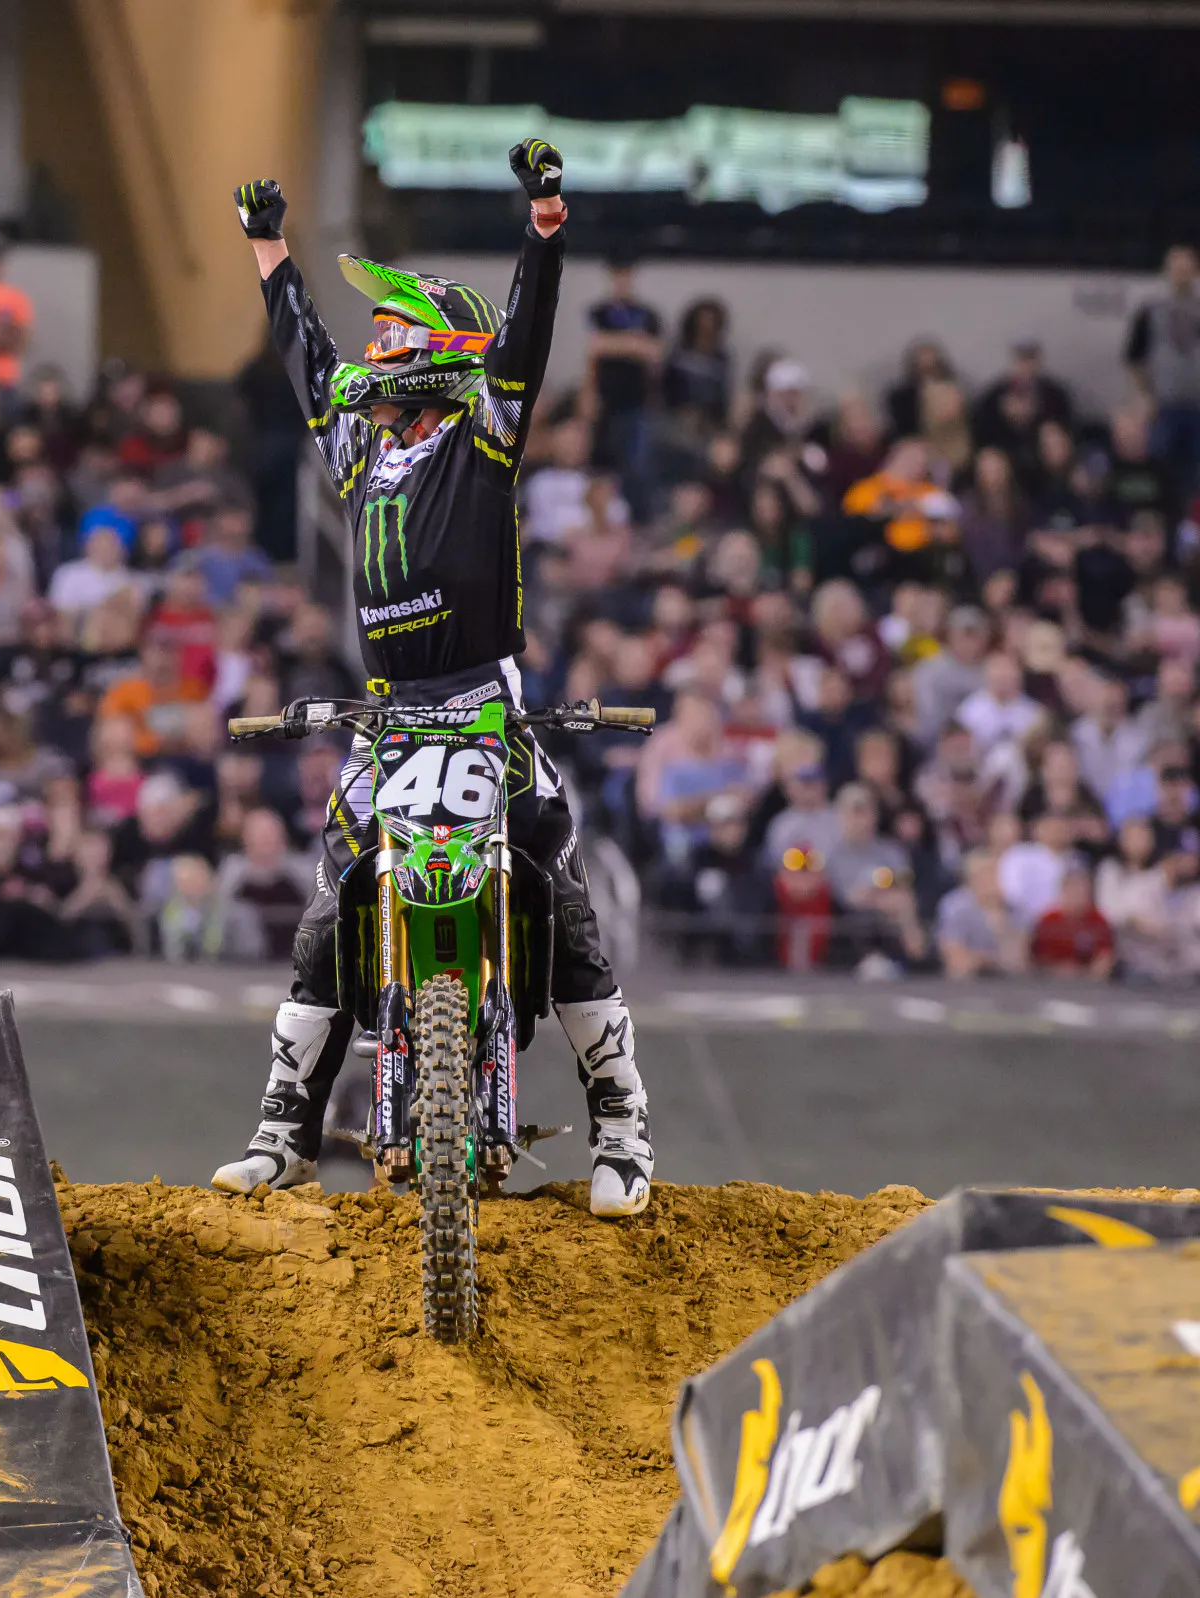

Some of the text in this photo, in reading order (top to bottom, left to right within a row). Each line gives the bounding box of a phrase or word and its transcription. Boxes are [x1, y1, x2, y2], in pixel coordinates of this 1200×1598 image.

[418, 280, 446, 296] VANS
[398, 371, 461, 386] MONSTER
[408, 382, 451, 391] ENERGY
[360, 589, 443, 626] Kawasaki
[388, 610, 452, 635] CIRCUIT
[386, 711, 480, 726] RENTHA
[564, 721, 595, 731] ARC
[376, 745, 505, 819] 46
[316, 862, 329, 897] thor
[382, 885, 392, 981] PRO CIRCUIT
[382, 1045, 393, 1135] UNLOP
[497, 1033, 510, 1133] DUNLOP
